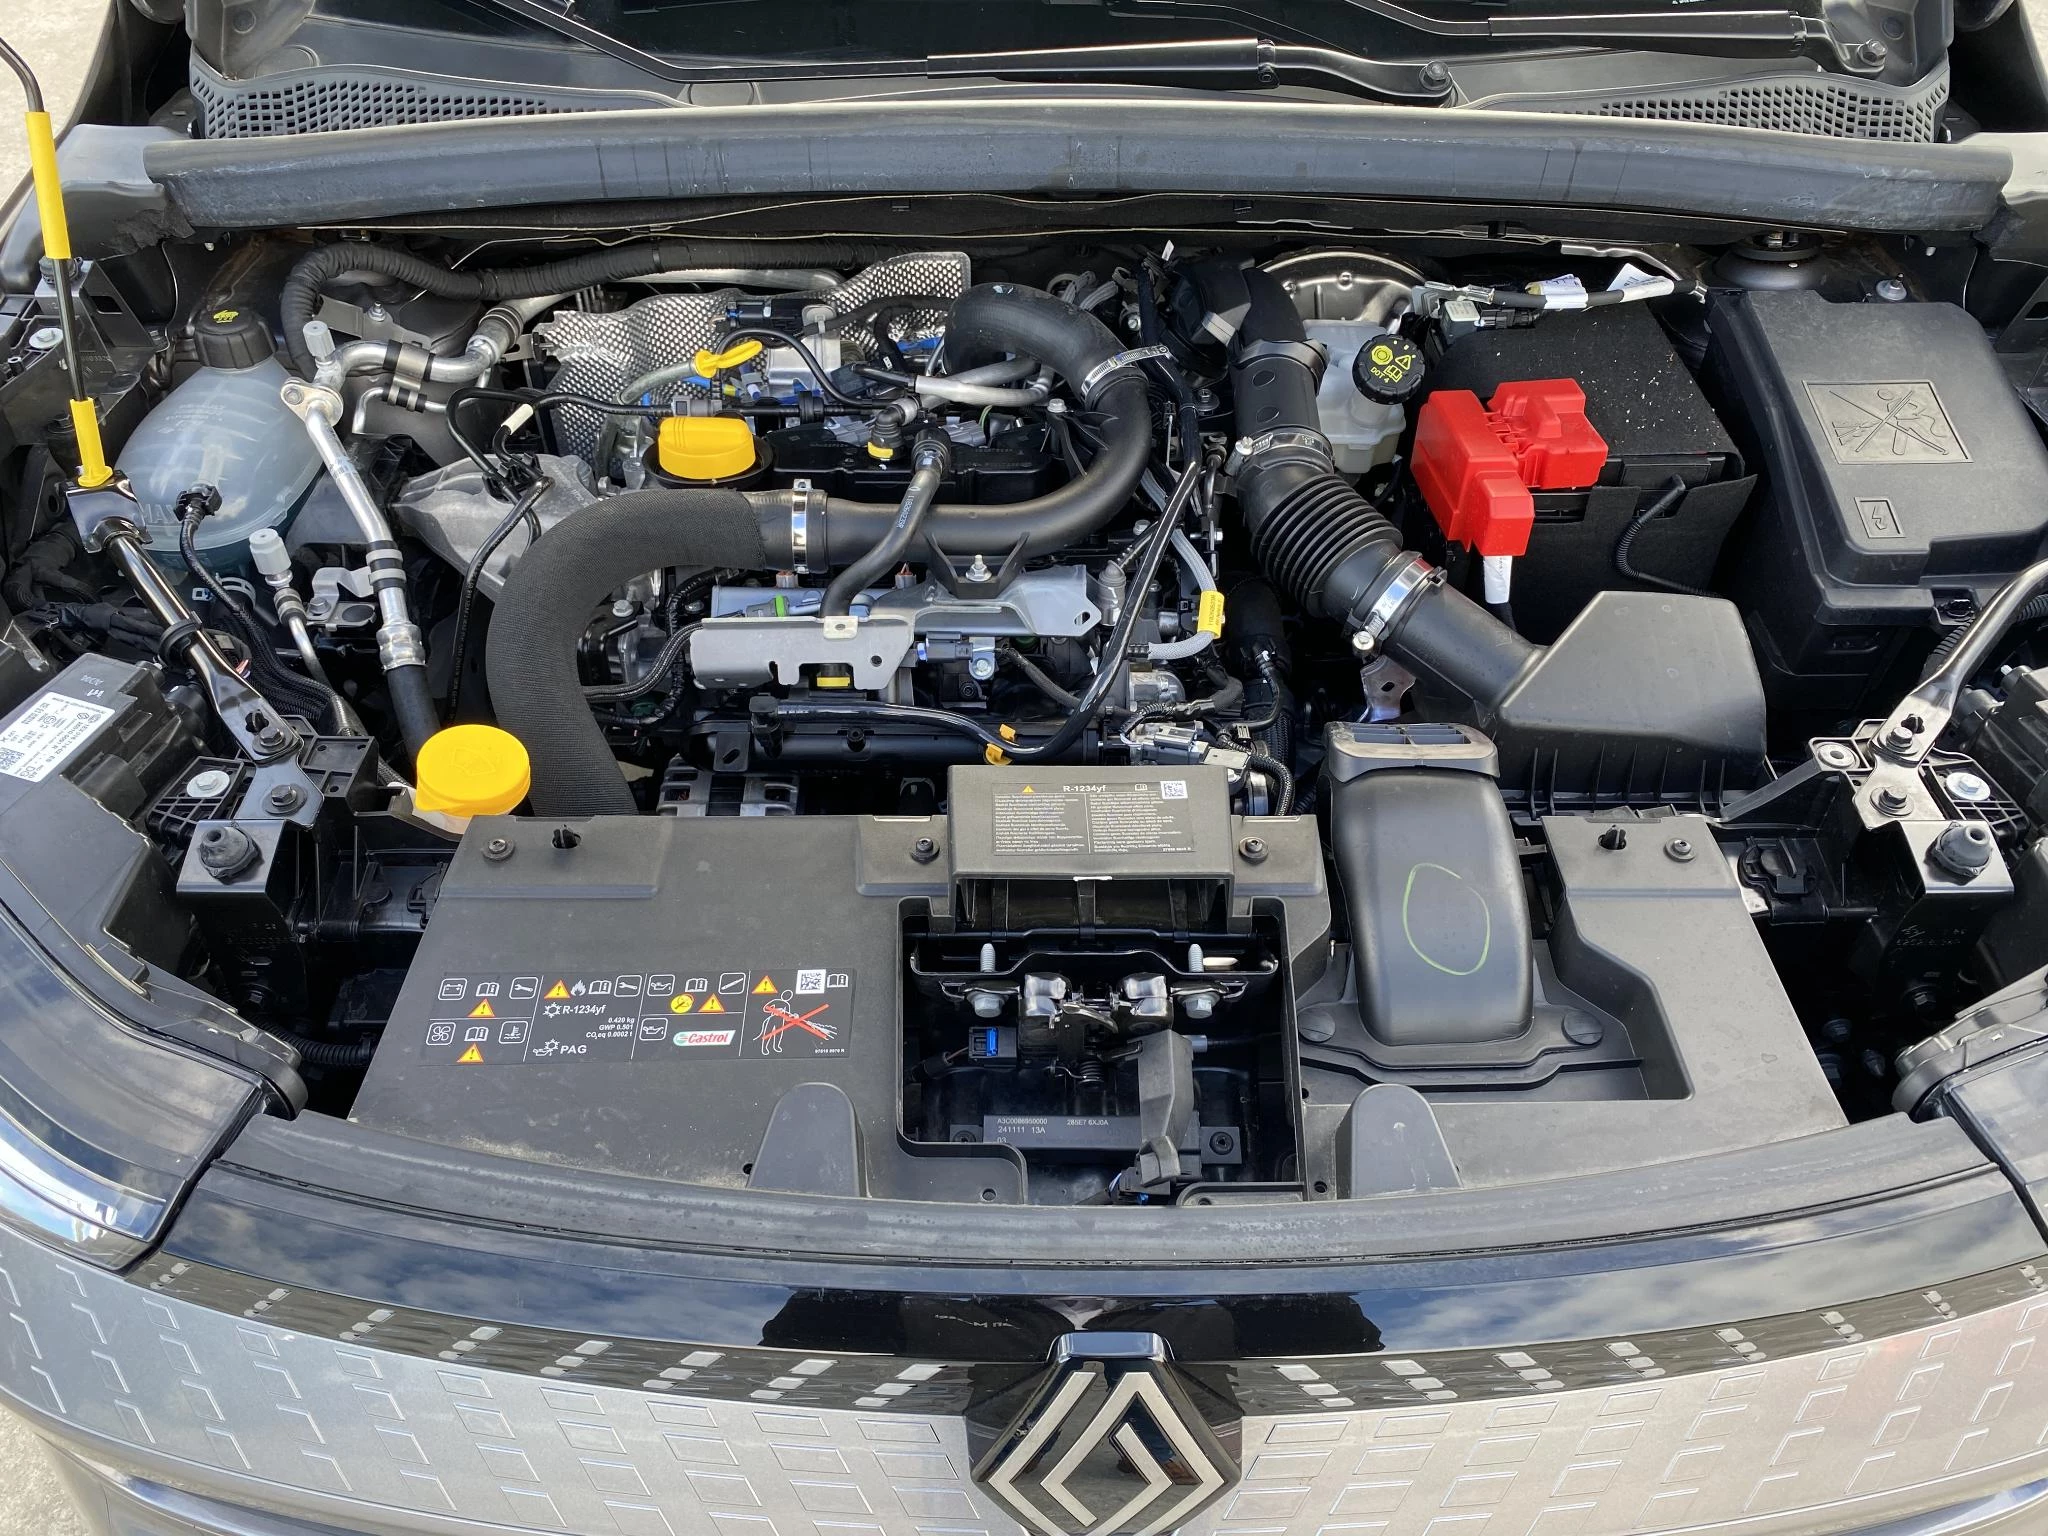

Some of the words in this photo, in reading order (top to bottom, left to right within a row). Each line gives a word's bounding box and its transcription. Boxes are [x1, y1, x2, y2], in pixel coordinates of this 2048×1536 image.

[1370, 366, 1386, 379] DOT
[1063, 785, 1106, 793] R-1234yf
[562, 1005, 606, 1016] R-1234yf
[688, 1033, 729, 1044] Castrol
[560, 1045, 587, 1054] PAG
[1031, 1126, 1046, 1134] 13A
